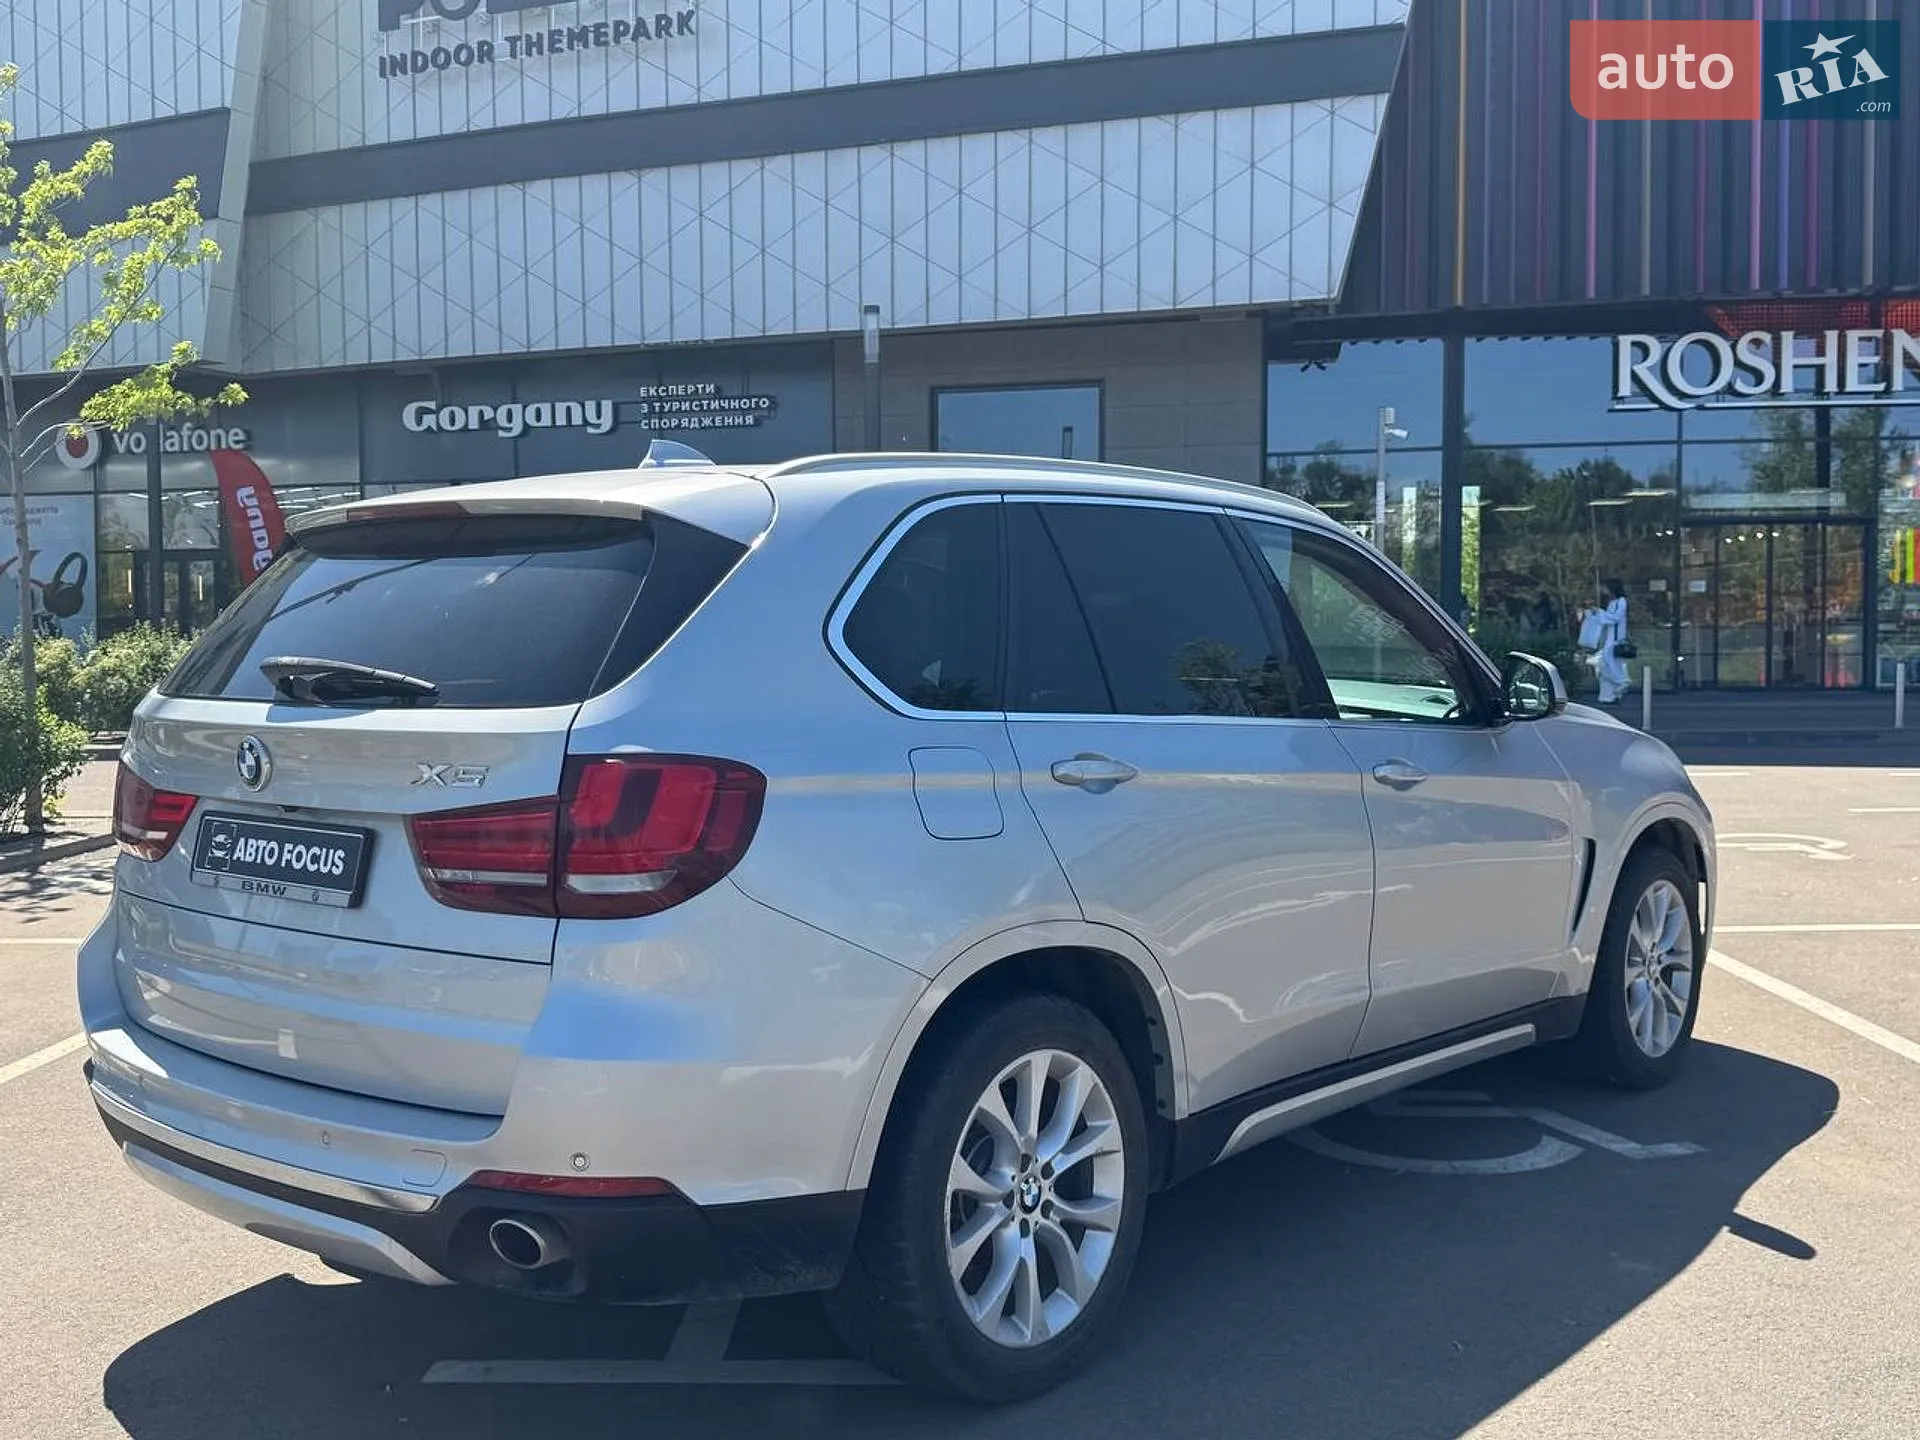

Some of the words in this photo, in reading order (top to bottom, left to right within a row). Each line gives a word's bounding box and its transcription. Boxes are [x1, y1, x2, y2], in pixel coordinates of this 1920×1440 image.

[378, 40, 495, 79] INDOOR
[504, 9, 697, 60] THEMEPARK
[639, 383, 716, 398] ЕКСПЕРТИ
[402, 399, 614, 438] Gorgany
[652, 397, 770, 413] ТУРИСТИЧНОГО
[640, 415, 755, 430] СПОРЯДЖЕННЯ
[112, 423, 248, 454] voafone
[411, 762, 490, 789] X5
[280, 843, 345, 876] FOCUS
[241, 880, 288, 897] BMW
